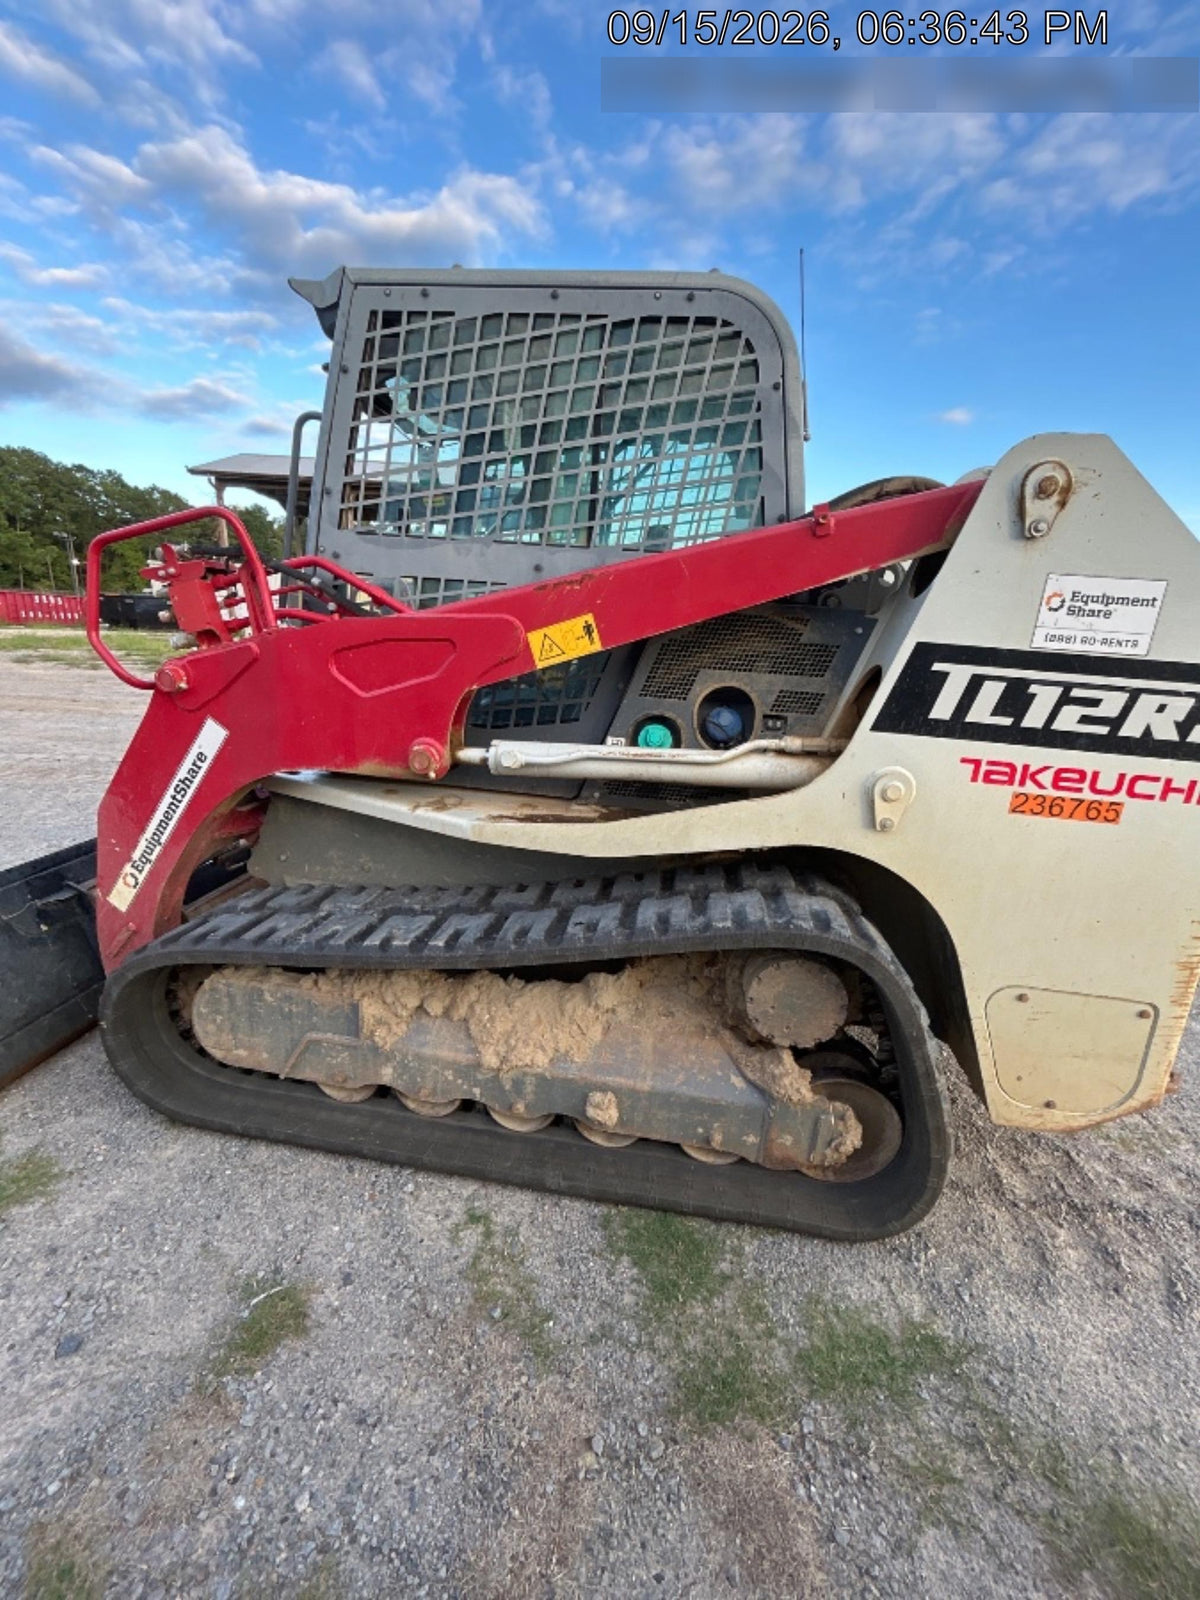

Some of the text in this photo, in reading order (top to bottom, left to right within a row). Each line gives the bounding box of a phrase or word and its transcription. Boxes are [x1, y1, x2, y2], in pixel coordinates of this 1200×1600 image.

[1070, 591, 1159, 608] Equipment
[1066, 604, 1113, 619] Share
[130, 750, 208, 877] EquipmentShare
[1011, 792, 1121, 822] 236765
